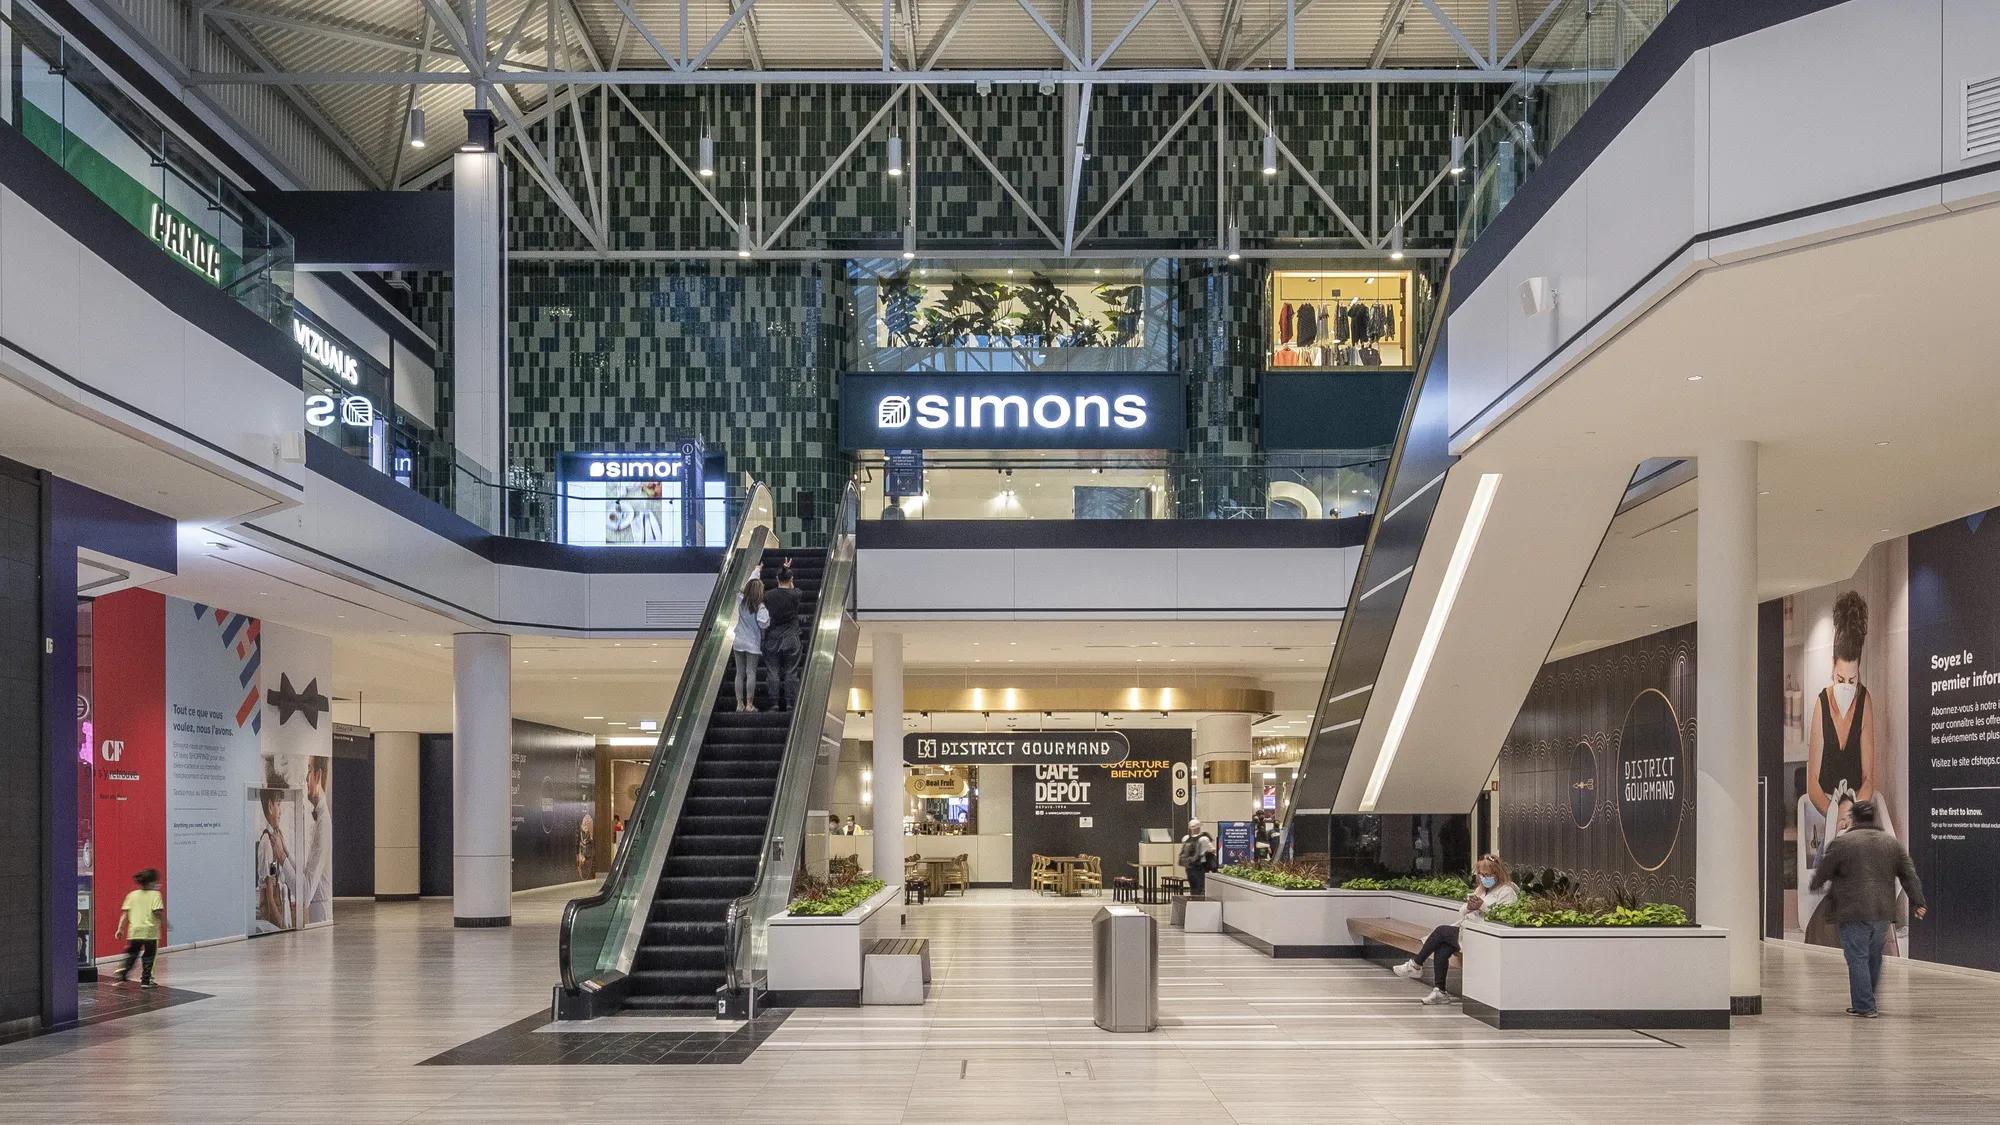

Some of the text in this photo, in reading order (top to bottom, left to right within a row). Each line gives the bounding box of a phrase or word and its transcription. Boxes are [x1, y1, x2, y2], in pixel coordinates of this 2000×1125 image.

[916, 394, 1147, 429] simons
[1931, 649, 1973, 671] Soyez le
[1931, 673, 1971, 696] premier
[173, 703, 223, 720] Tout ce que vous
[1931, 704, 1974, 716] Abonnez-vous
[1974, 701, 1979, 711] à
[1980, 701, 1997, 711] notre
[173, 722, 195, 735] voulez,
[196, 725, 211, 735] nous
[1931, 721, 1945, 732] pour
[1946, 717, 1974, 729] connaître
[1975, 716, 1985, 726] les
[1931, 735, 1940, 744] les
[1979, 731, 1986, 741] et
[101, 739, 125, 762] CF
[941, 742, 1015, 755] DISTRICT
[1021, 742, 1110, 755] GOURMAND
[1625, 756, 1675, 780] DISTRICT
[1931, 757, 1951, 768] Visitez
[1951, 757, 1958, 767] le
[1959, 756, 1970, 767] site
[1110, 769, 1159, 778] BIENTÔT
[1035, 780, 1091, 802] DÉPÔT
[1625, 780, 1675, 801] GOURMAND
[1931, 807, 1938, 816] Be
[1939, 807, 1948, 816] the
[1948, 807, 1959, 816] first
[1959, 808, 1966, 816] to
